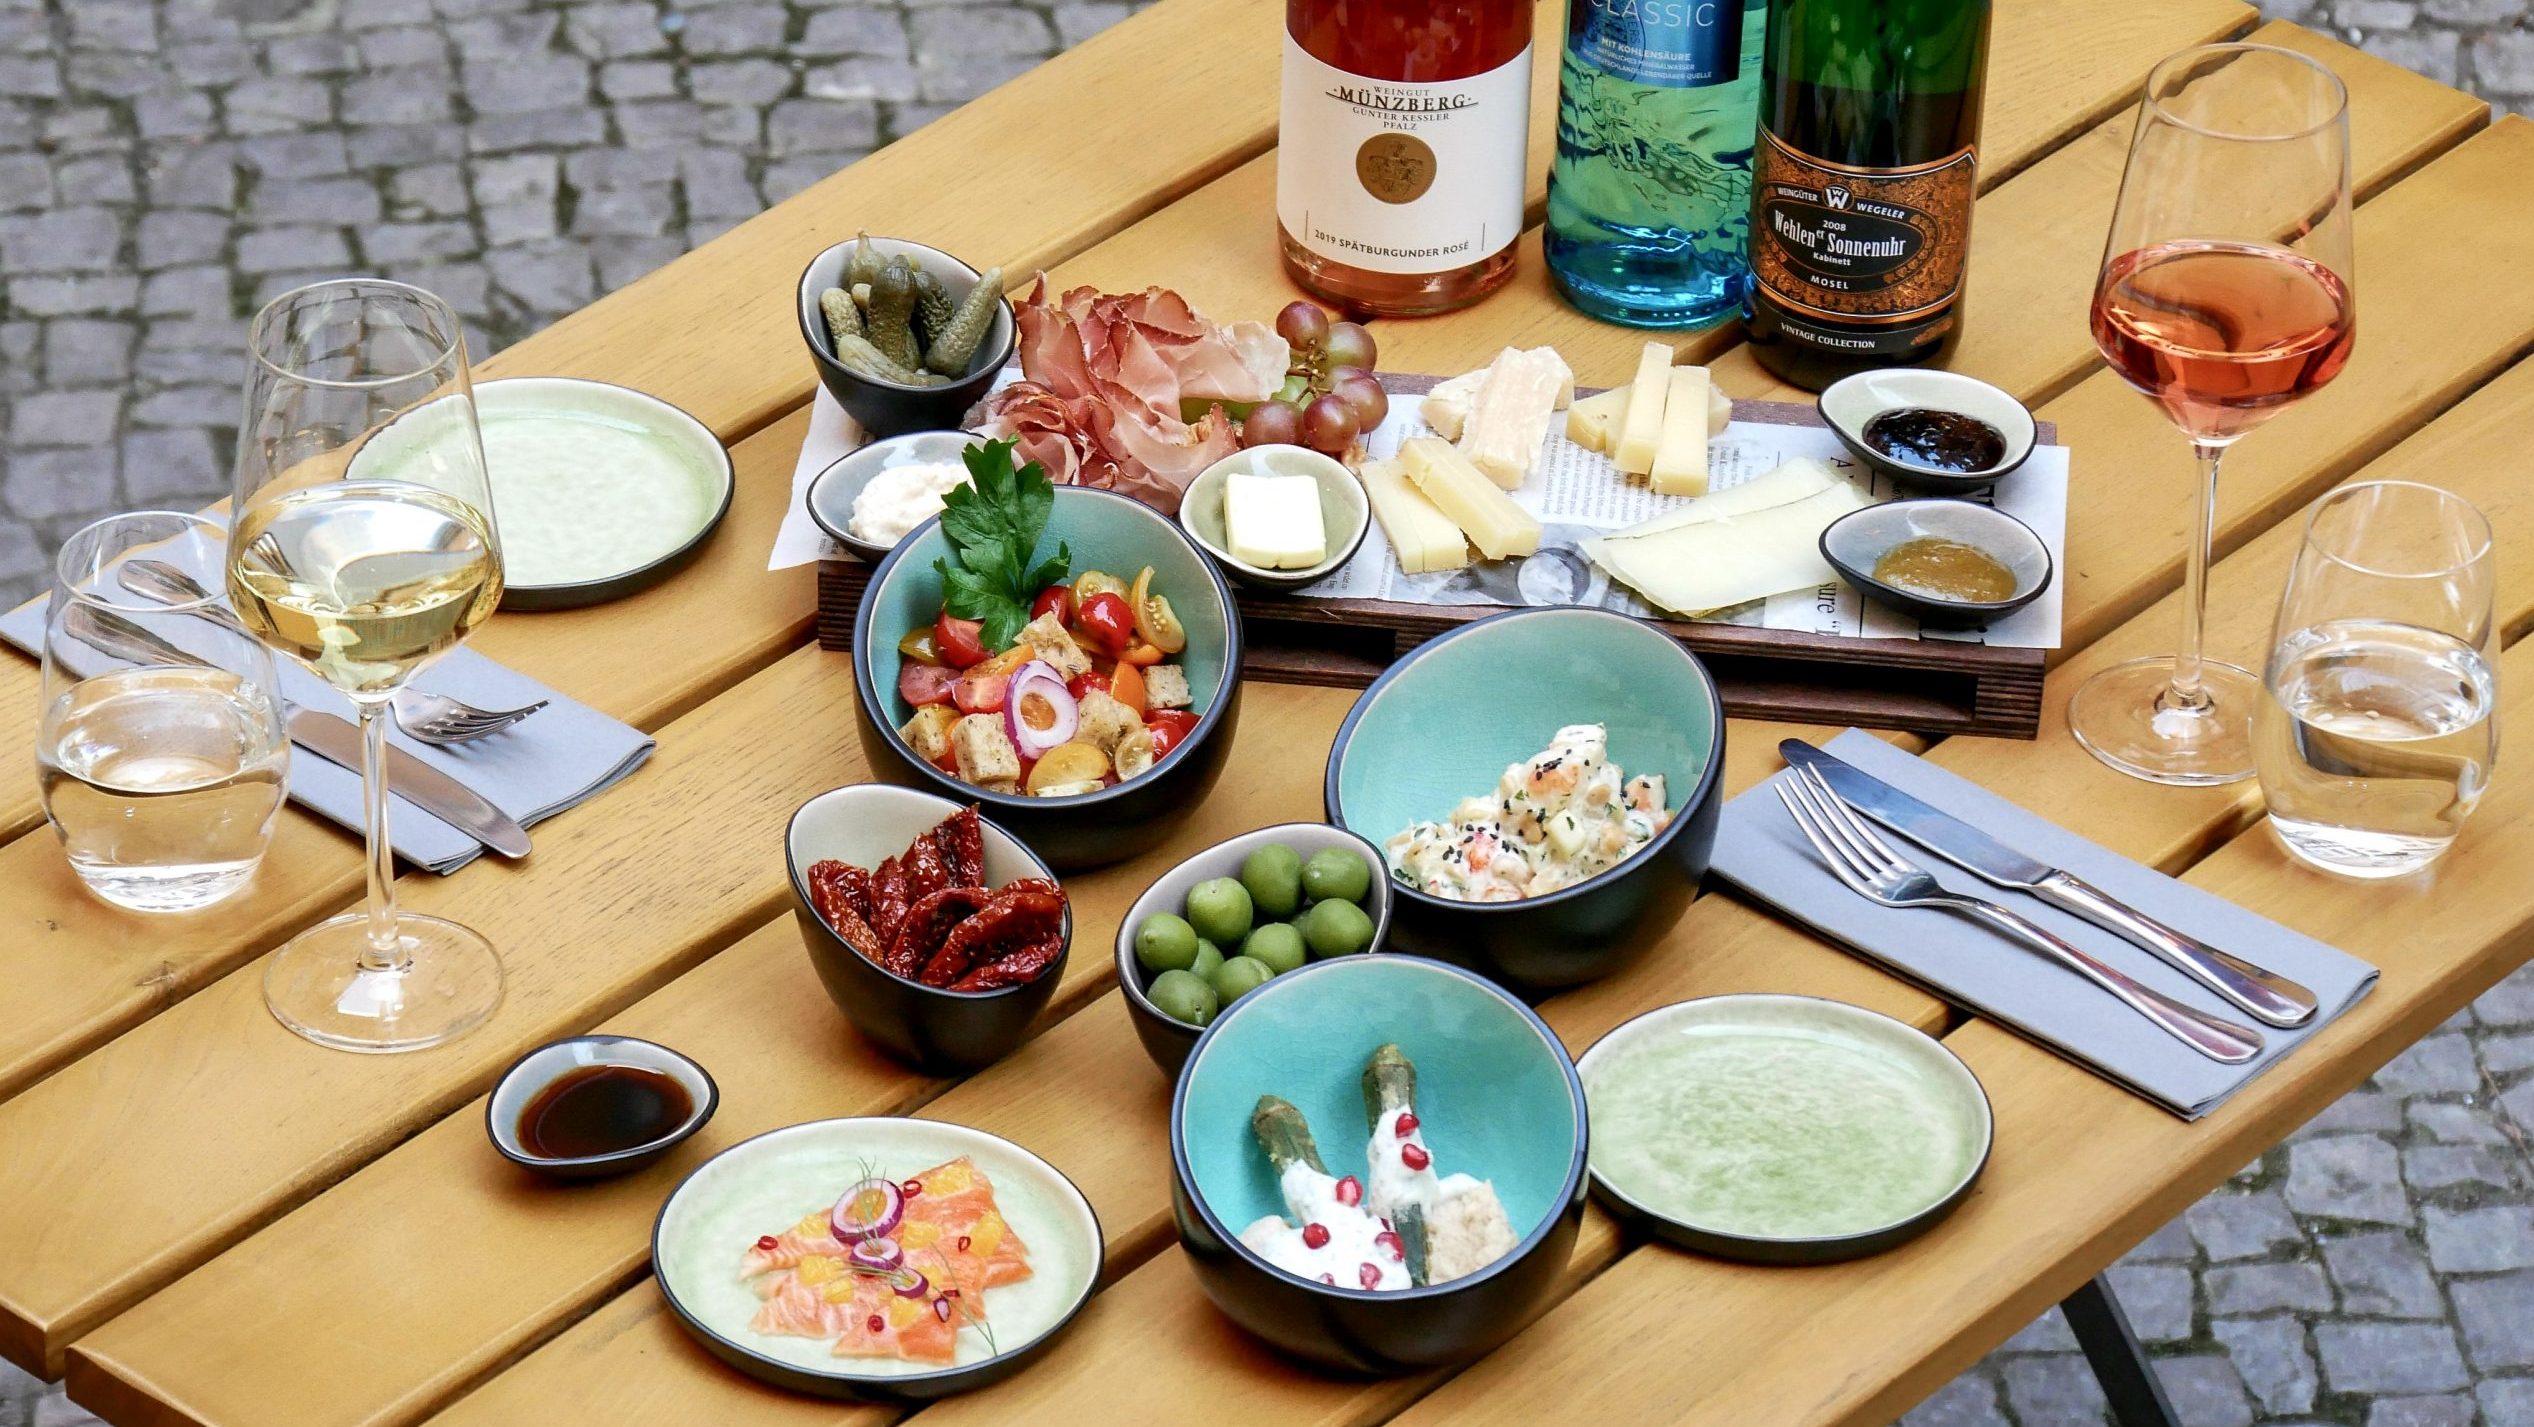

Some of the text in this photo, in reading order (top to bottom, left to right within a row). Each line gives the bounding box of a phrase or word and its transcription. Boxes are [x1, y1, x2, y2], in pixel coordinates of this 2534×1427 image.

[1592, 0, 1716, 28] LASSIC
[1601, 37, 1692, 60] MIT KOHLENSÄURE
[1687, 71, 1712, 80] QUELLE
[1374, 86, 1431, 96] WEINGUT
[1402, 112, 1450, 121] KESSLER
[1383, 121, 1417, 130] PFALZ
[1777, 187, 1818, 201] WEINGÜTER
[1856, 202, 1905, 220] WEGELER
[1822, 220, 1847, 231] 2008
[1315, 229, 1469, 258] 2019 SPÄTBURGUNDER ROSÉ
[1828, 232, 1906, 257] Sonnenuhr
[1813, 252, 1851, 266] Kabinett
[1811, 275, 1849, 290] MOSEL
[1781, 322, 1875, 349] VINTAGE COLLECTION
